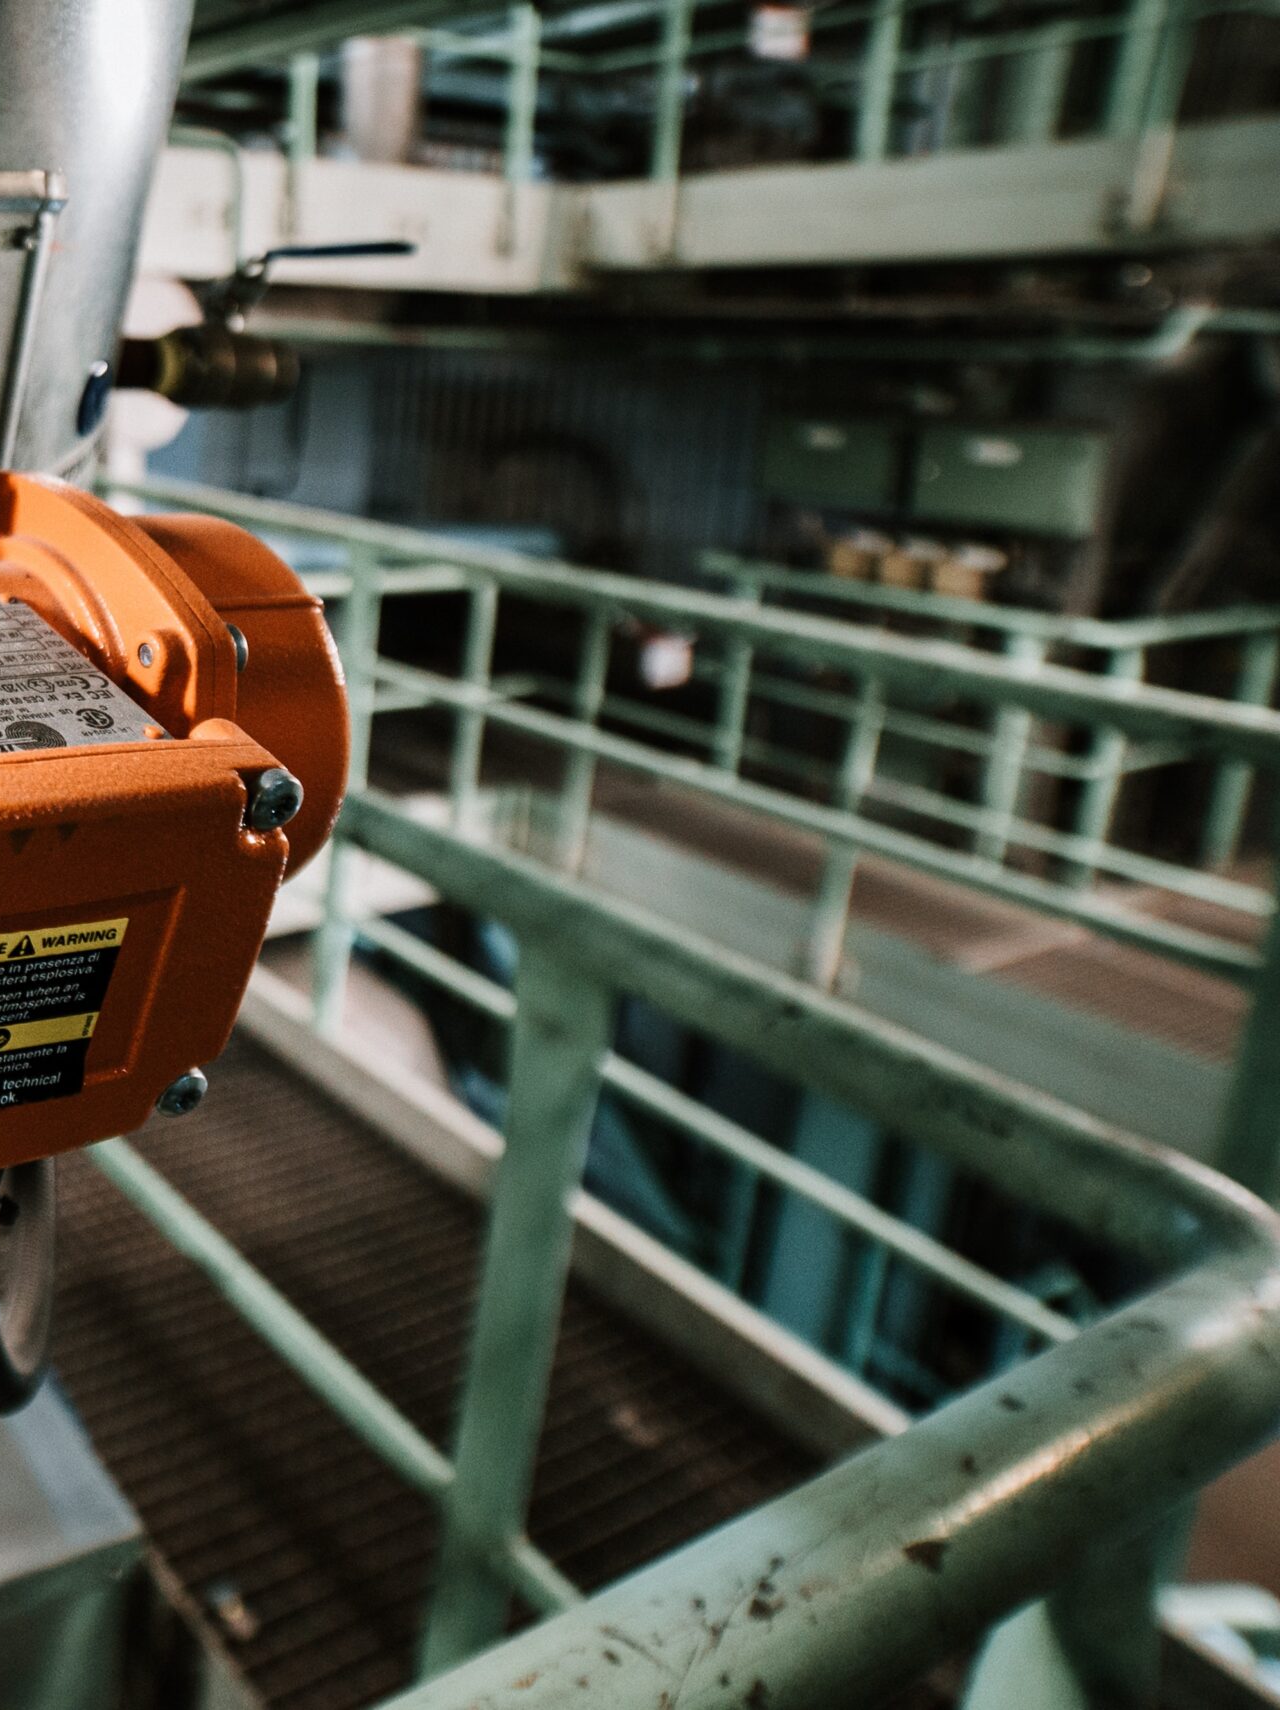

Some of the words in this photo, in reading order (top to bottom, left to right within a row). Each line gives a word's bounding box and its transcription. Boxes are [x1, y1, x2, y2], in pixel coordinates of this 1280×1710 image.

[63, 692, 85, 701] Ex
[87, 690, 114, 700] IEC
[42, 928, 117, 948] WARNING
[9, 962, 21, 973] in
[25, 956, 84, 973] presenza
[88, 952, 100, 962] di
[31, 966, 95, 982] esplosiva.
[26, 985, 60, 997] when
[63, 983, 79, 992] an
[75, 992, 85, 1000] is
[57, 1045, 67, 1053] la
[3, 1072, 61, 1089] technical
